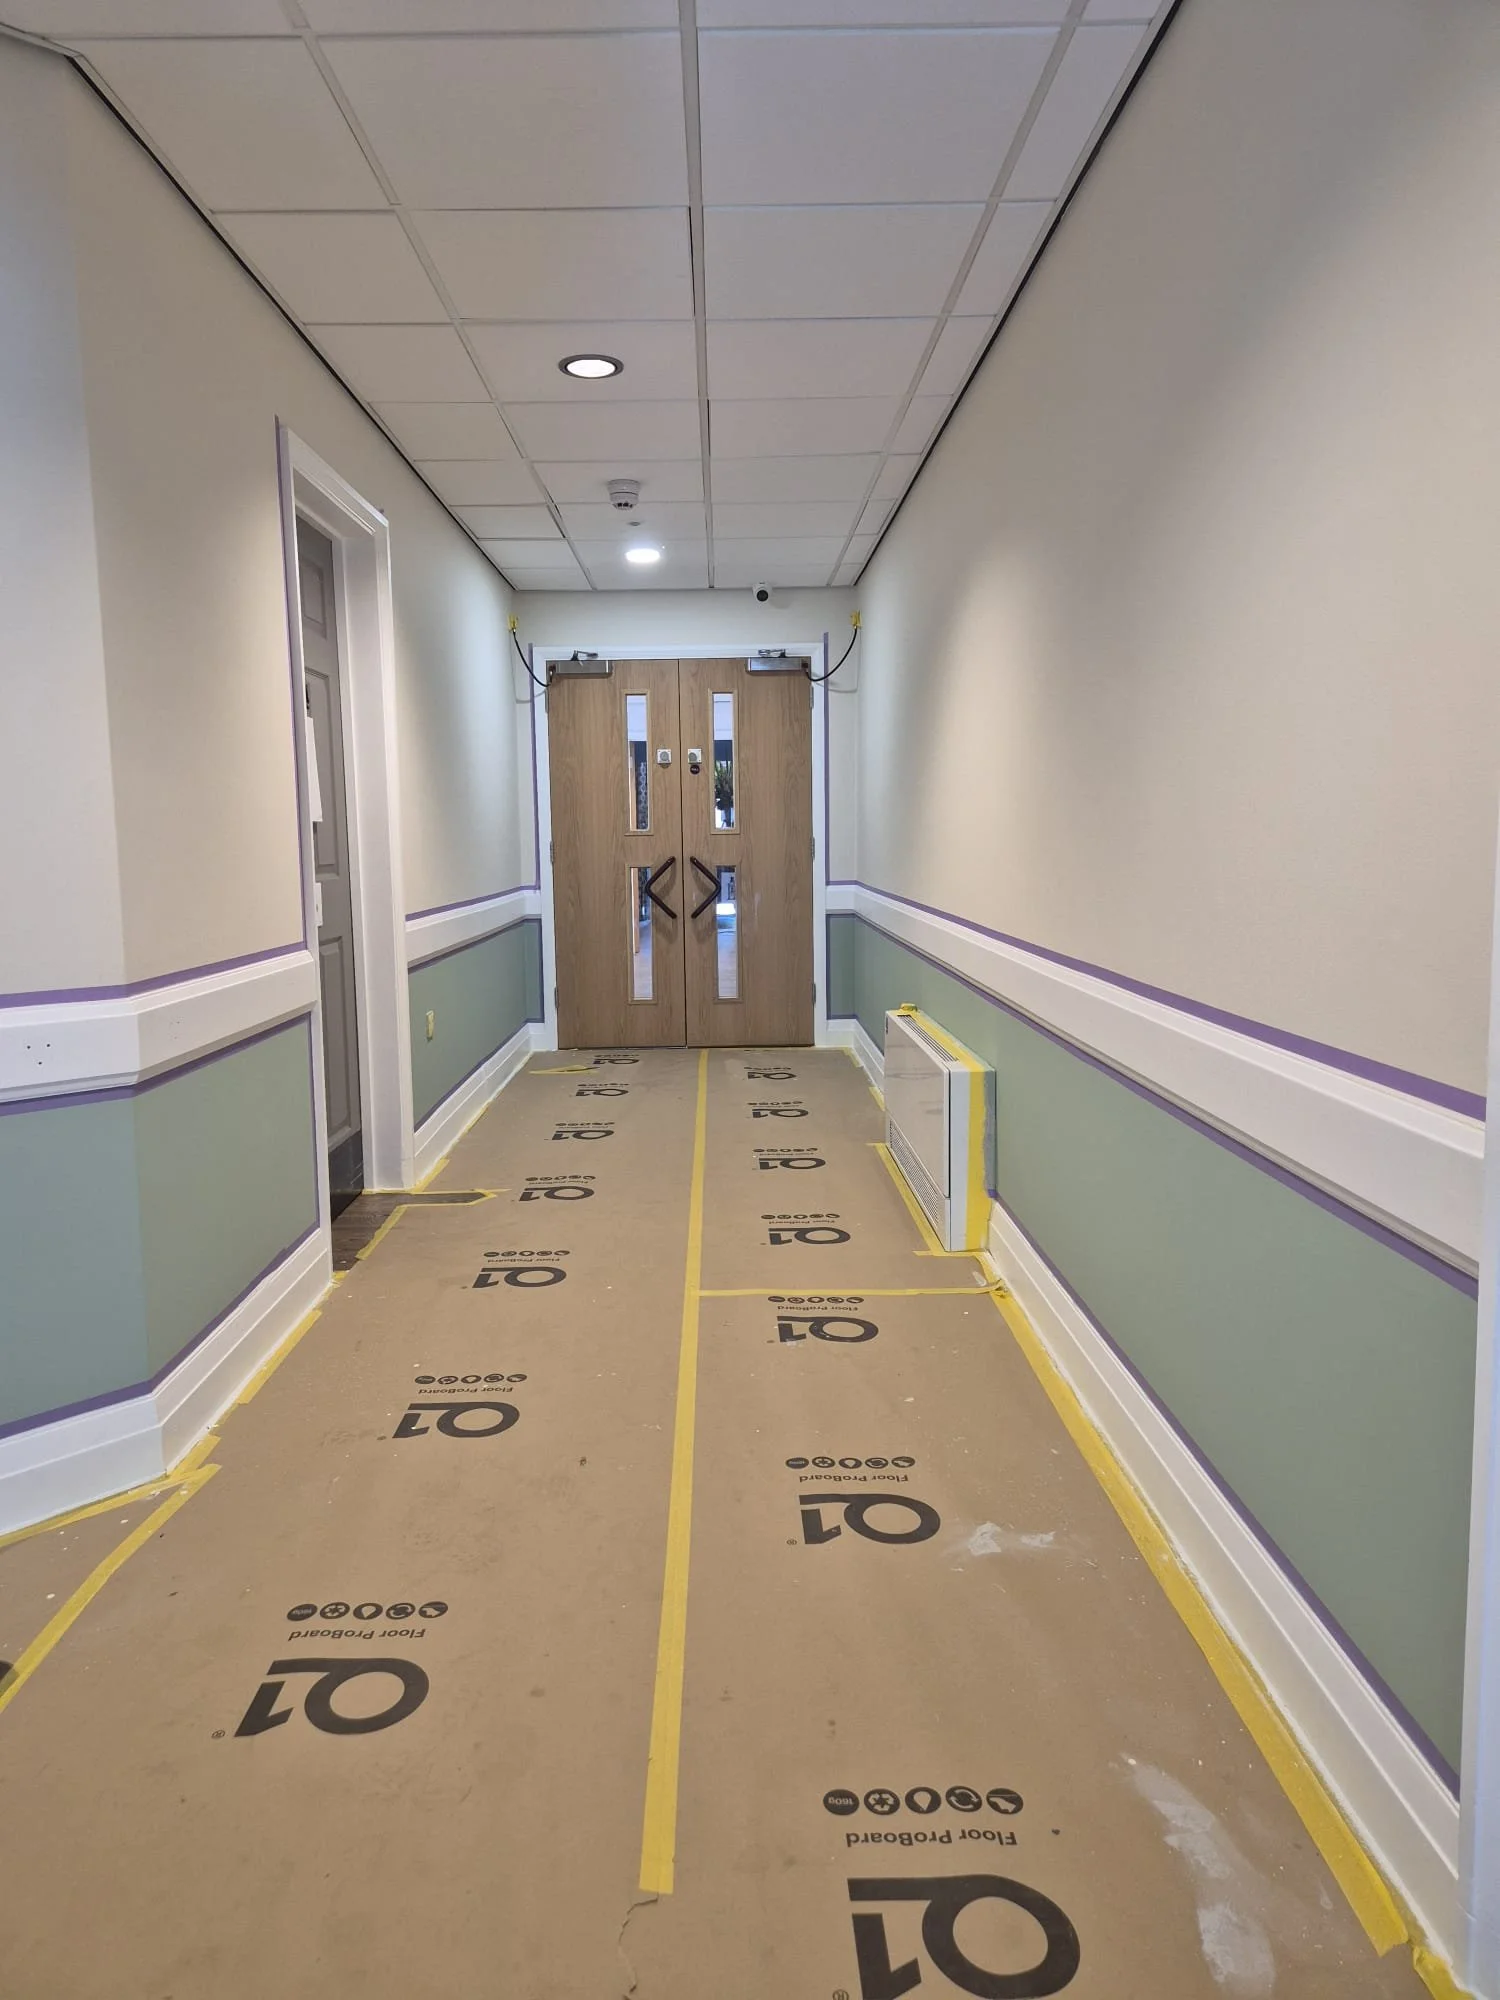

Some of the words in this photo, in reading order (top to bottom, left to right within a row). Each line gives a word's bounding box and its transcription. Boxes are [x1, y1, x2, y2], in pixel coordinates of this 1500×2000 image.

[799, 1474, 868, 1483] ProBoard
[871, 1474, 909, 1483] Floor
[288, 1629, 375, 1641] ProBoard
[379, 1628, 426, 1639] Floor
[846, 1829, 953, 1848] ProBoard
[958, 1828, 1018, 1846] Floor
